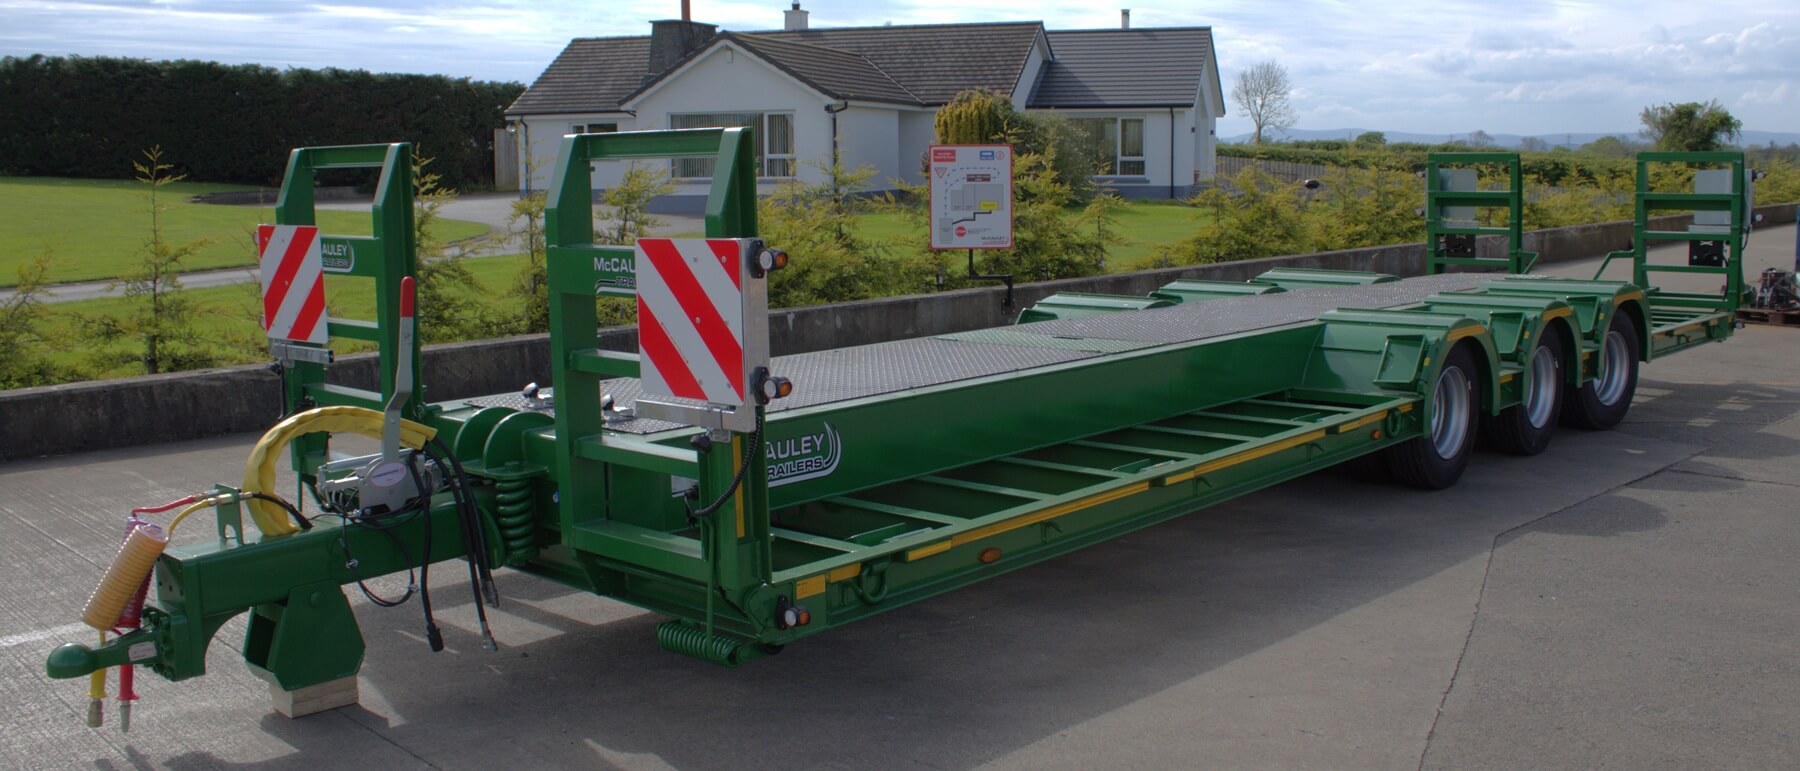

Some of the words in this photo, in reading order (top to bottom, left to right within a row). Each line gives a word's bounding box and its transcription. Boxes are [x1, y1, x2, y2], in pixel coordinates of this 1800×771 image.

[322, 243, 348, 256] AULEY
[593, 256, 636, 273] McCAU
[766, 433, 824, 460] AULEY
[767, 455, 824, 479] RAILERS
